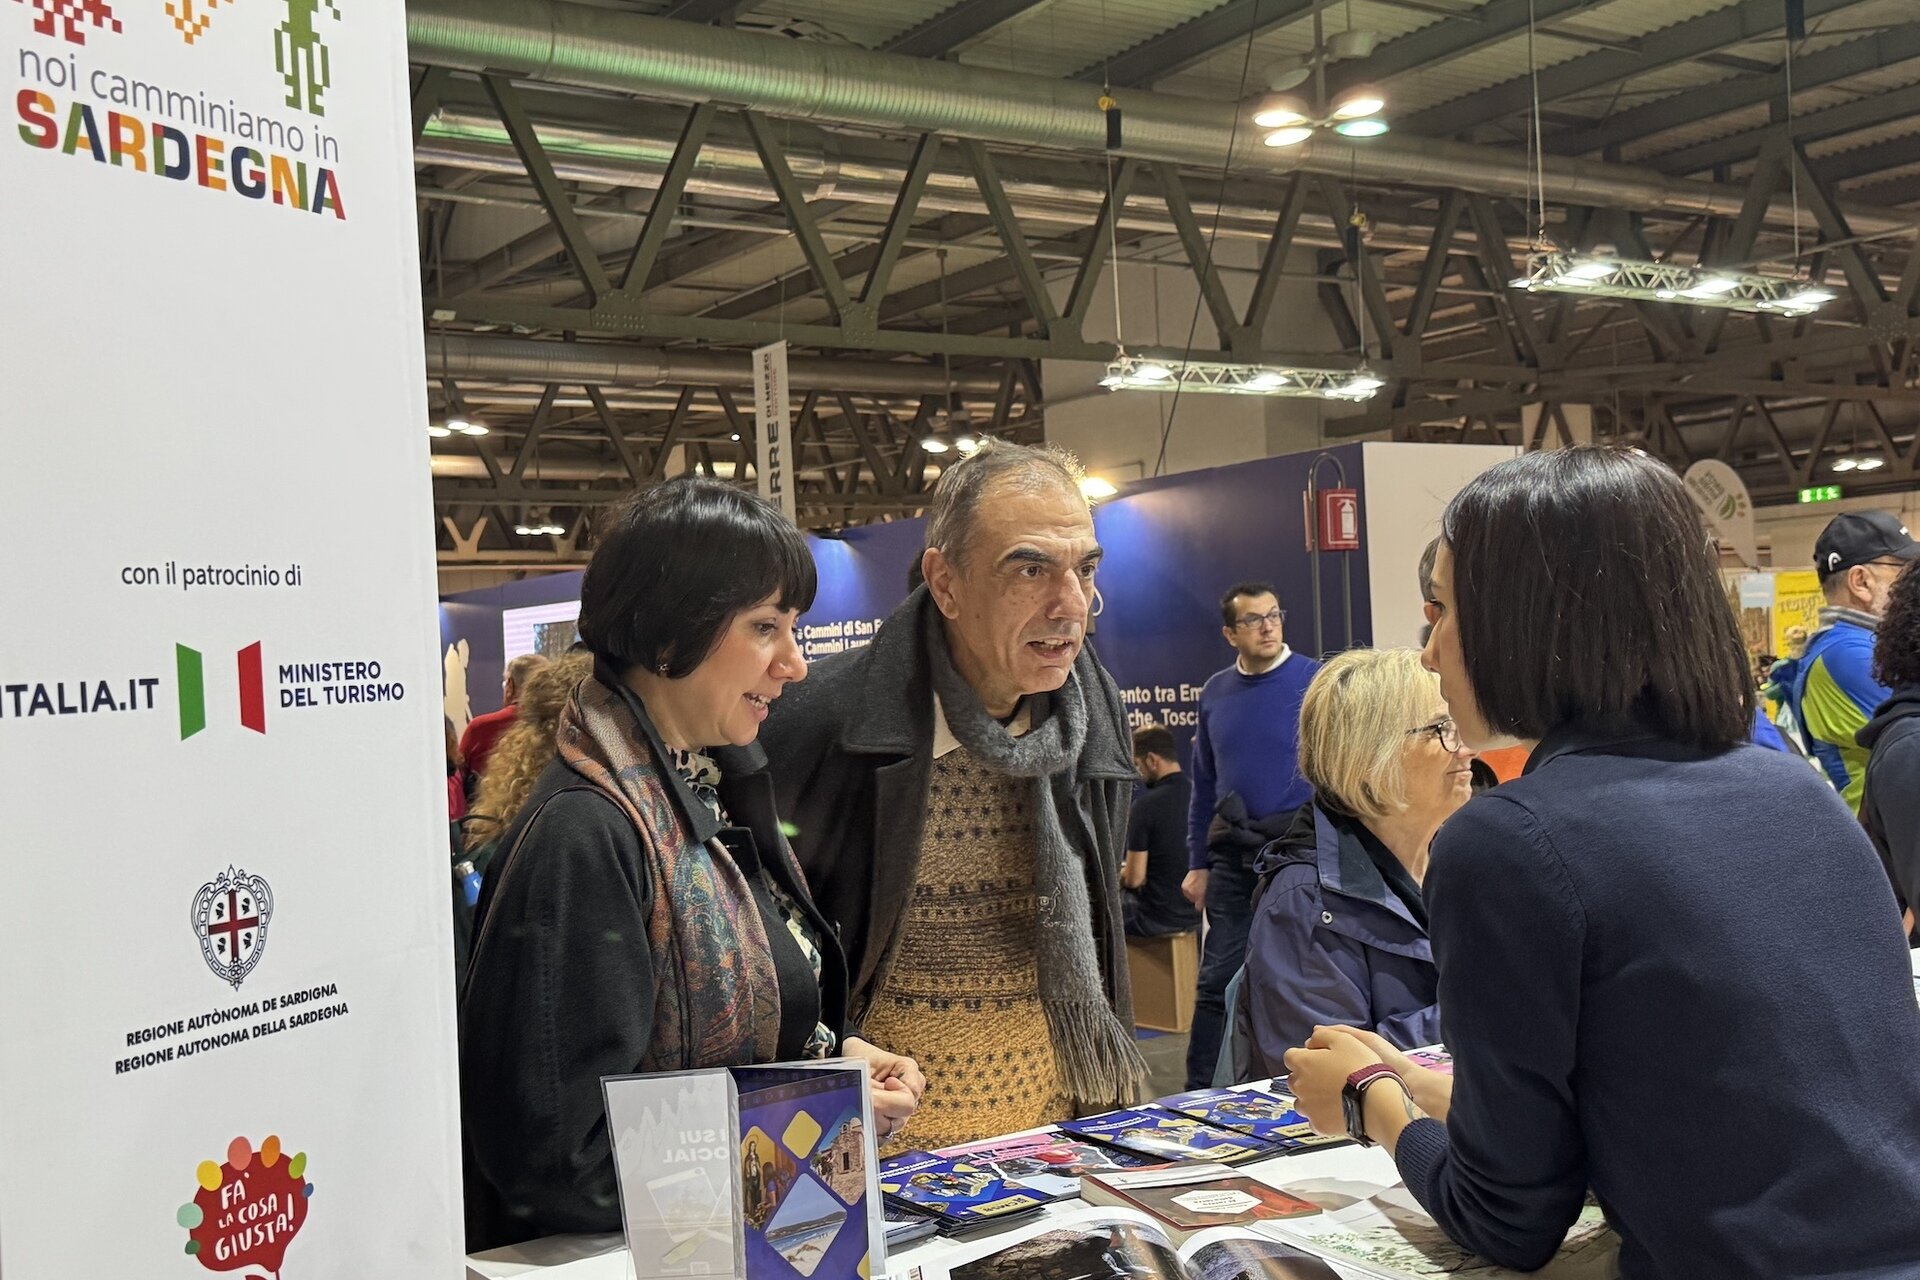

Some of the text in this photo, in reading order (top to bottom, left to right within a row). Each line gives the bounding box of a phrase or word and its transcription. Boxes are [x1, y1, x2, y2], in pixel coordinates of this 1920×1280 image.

[19, 47, 339, 163] noi camminiamo in
[16, 88, 346, 220] SARDEGNA
[766, 405, 772, 418] DI
[121, 561, 302, 591] con il patrocinio di
[803, 621, 843, 640] Cammini
[844, 619, 854, 636] di
[855, 619, 873, 636] San
[805, 638, 844, 656] Cammini
[279, 661, 381, 684] MINISTERO
[280, 682, 404, 708] DEL TURISMO
[1154, 685, 1176, 703] tra
[126, 983, 338, 1047] REGIONE AUTÒNOMA DE SARDIGNA
[115, 1002, 349, 1075] REGIONE AUTONOMA DELLA SARDEGNA
[218, 1193, 278, 1229] LA COSA
[215, 1192, 294, 1261] GIUSTA!
